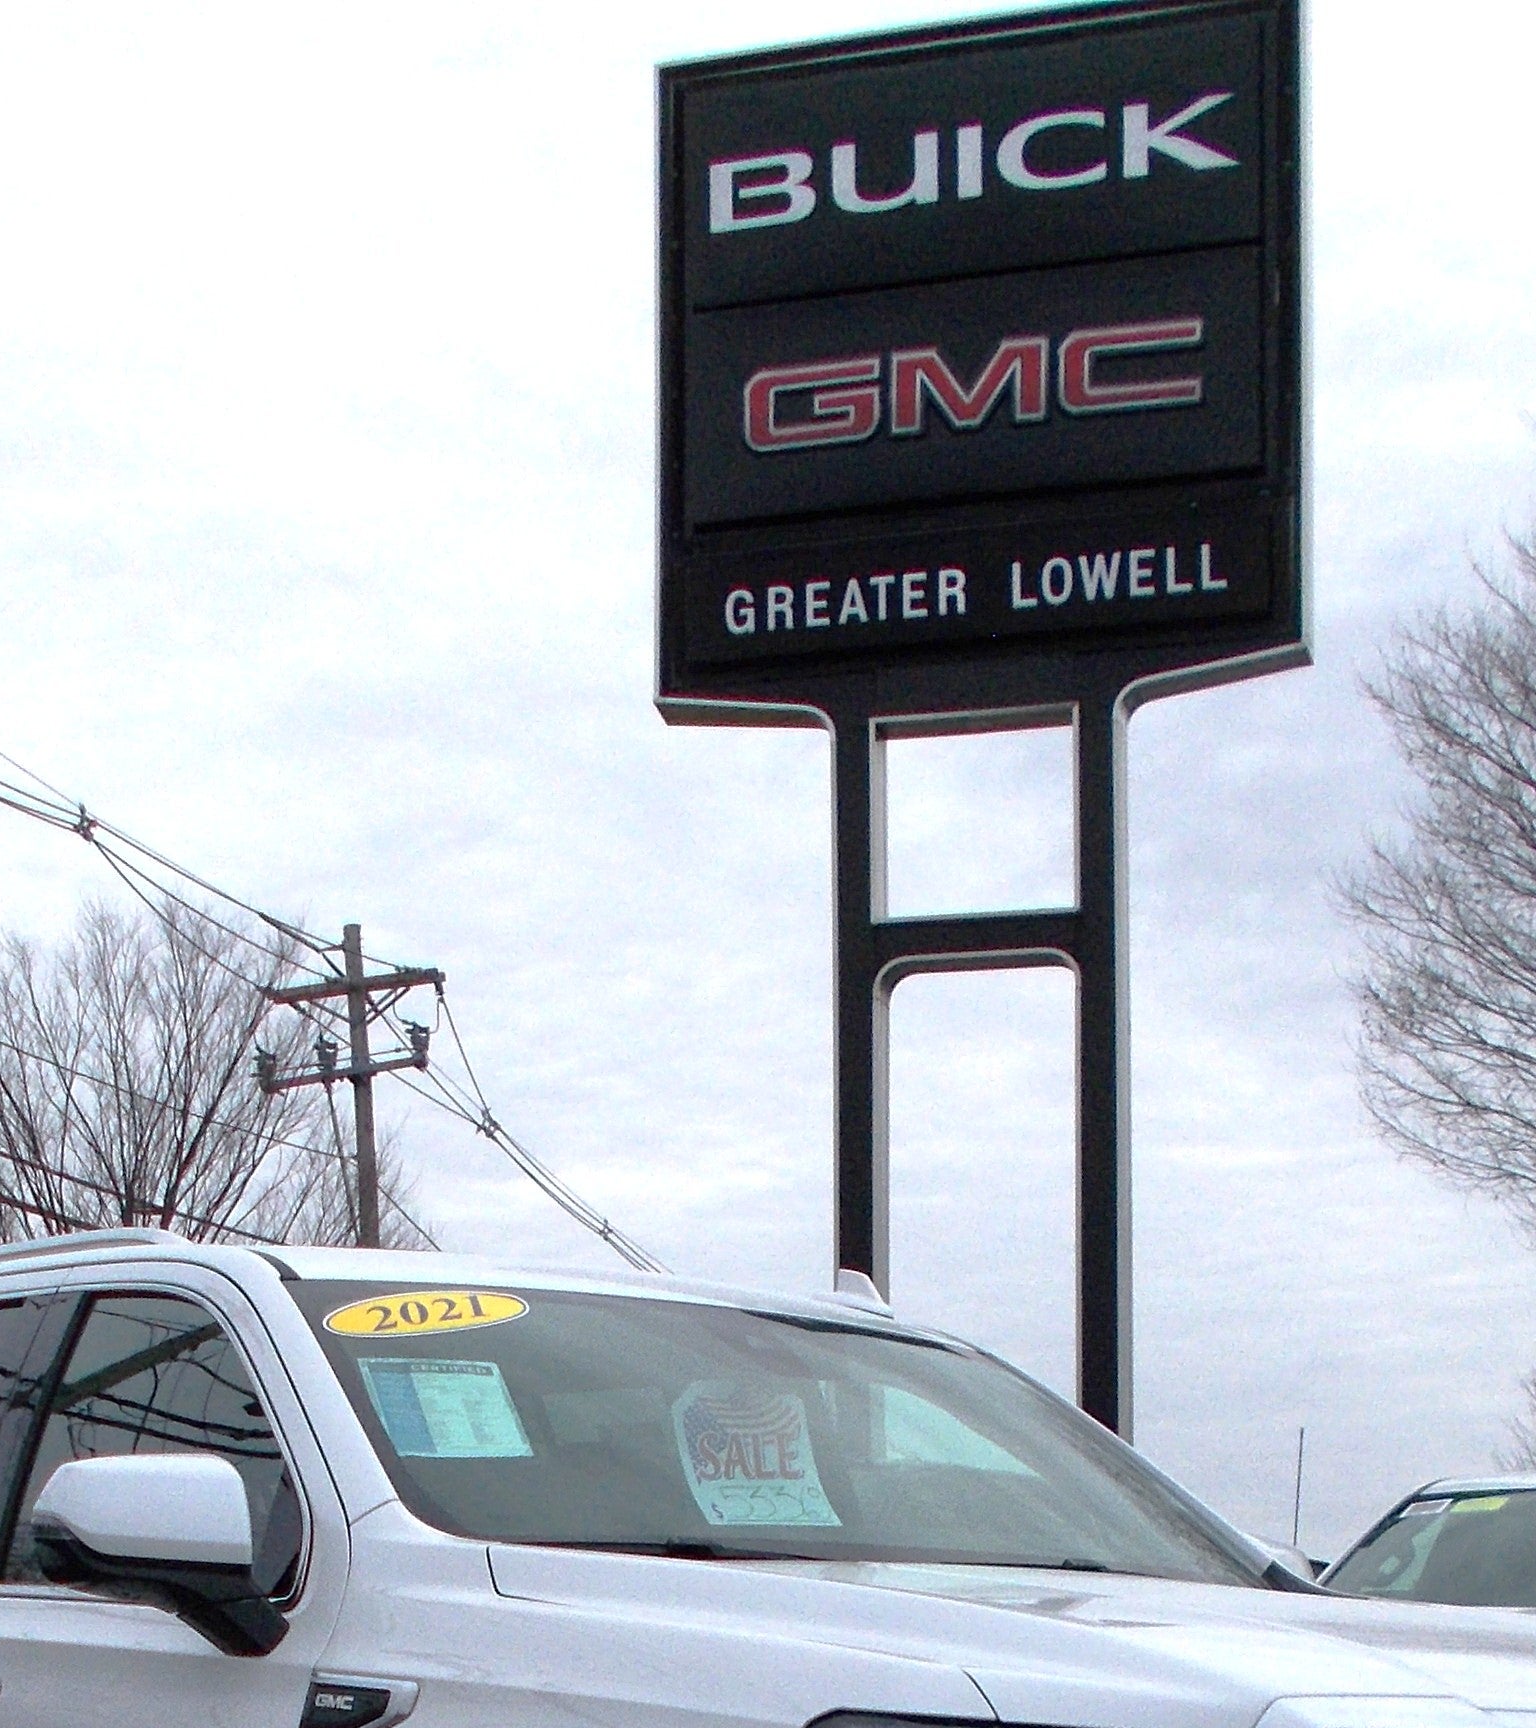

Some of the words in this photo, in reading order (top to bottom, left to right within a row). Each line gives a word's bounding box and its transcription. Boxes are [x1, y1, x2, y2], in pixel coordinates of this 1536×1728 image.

[709, 89, 1241, 233] BUICK
[743, 317, 1203, 452] GMC
[725, 568, 967, 636] GREATER
[1010, 542, 1228, 610] LOWELL
[366, 1294, 490, 1332] 2021
[696, 1431, 805, 1482] SALE
[315, 1692, 355, 1711] GMC
